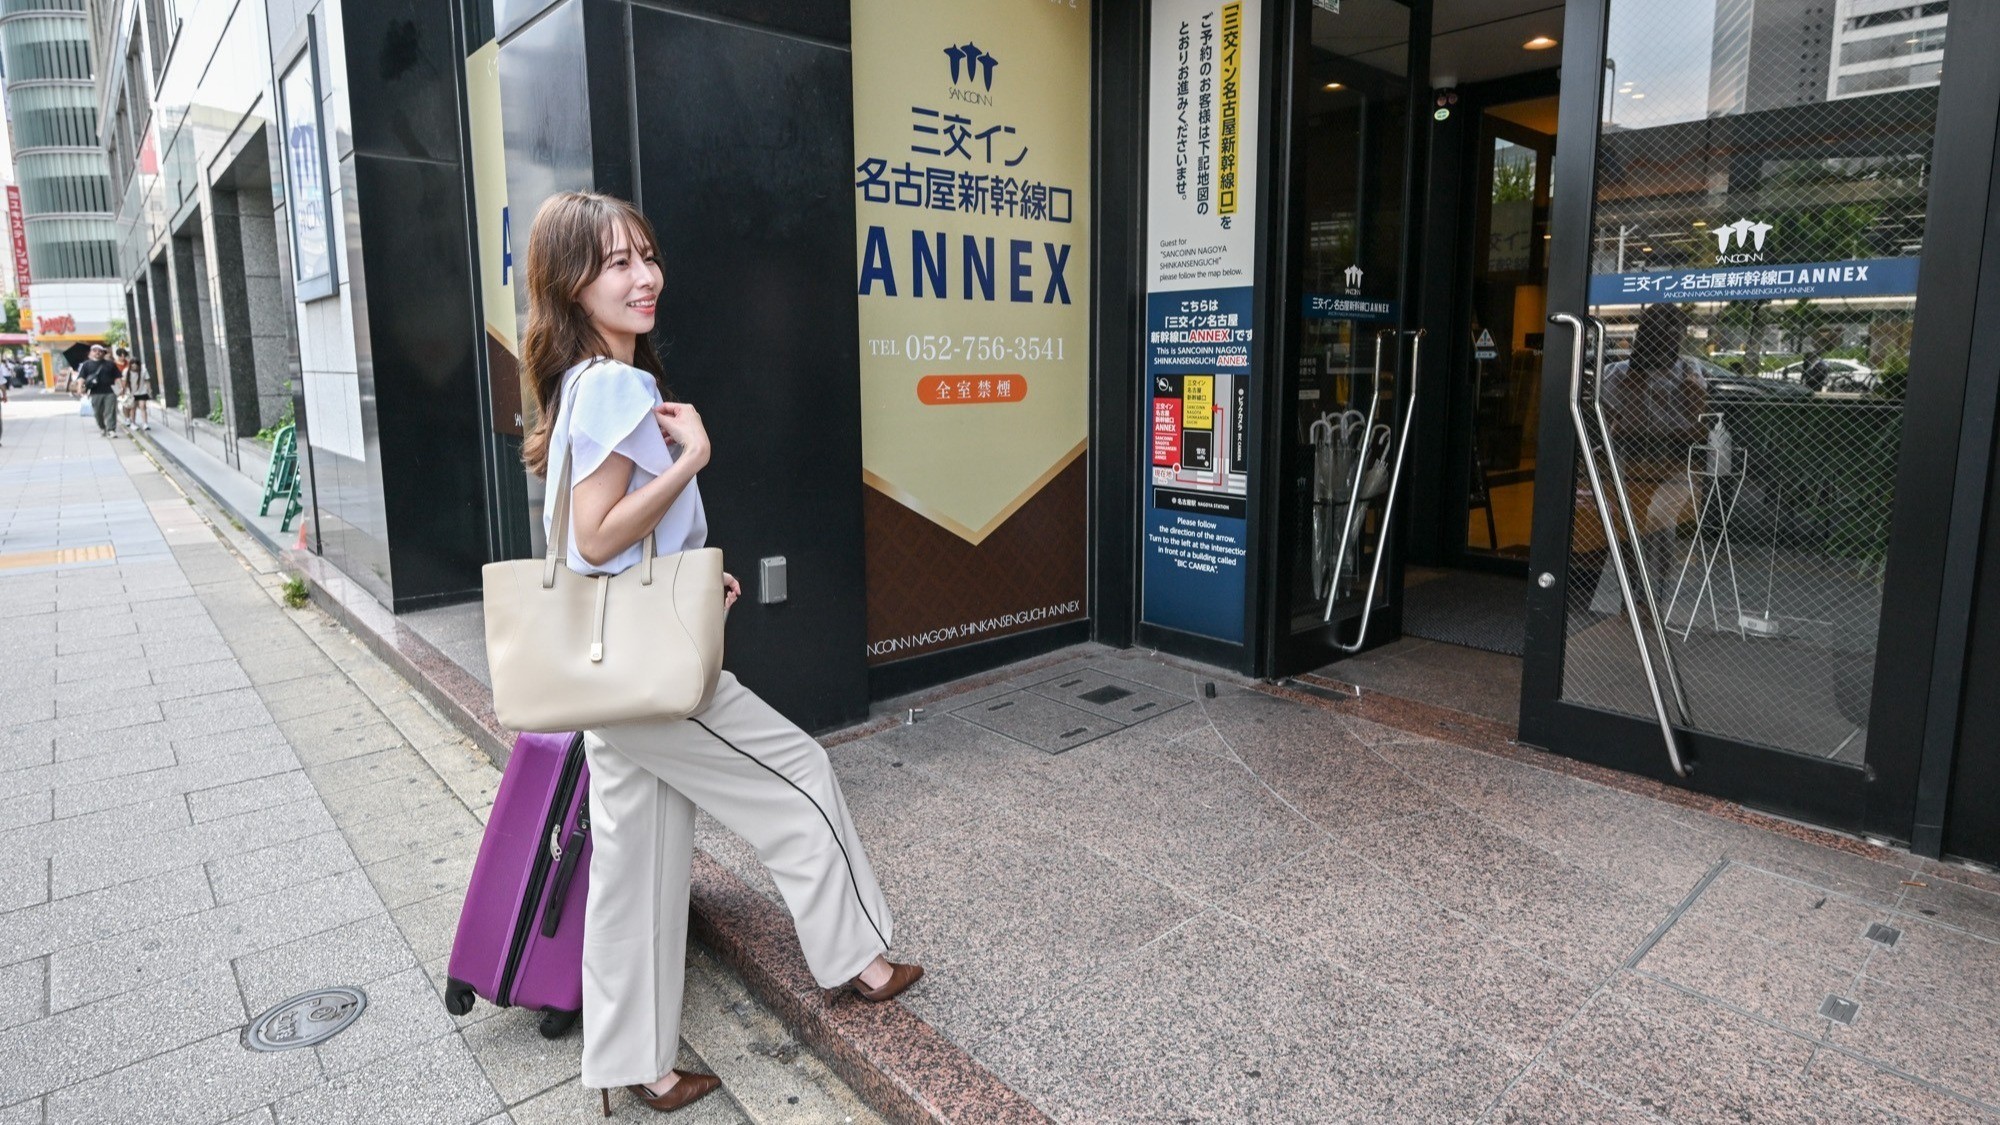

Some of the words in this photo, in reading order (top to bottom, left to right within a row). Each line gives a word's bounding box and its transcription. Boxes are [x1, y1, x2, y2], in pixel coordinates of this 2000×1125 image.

[948, 86, 993, 107] SANCOINN
[1176, 21, 1190, 200] とおりお進みくださいませ。
[1197, 11, 1213, 215] ご予約のお客様は下記地図の
[1219, 4, 1240, 230] 「三交イン名古屋新幹線口」を
[911, 106, 1028, 167] 三交イン
[855, 157, 1072, 223] 名古屋新幹線口
[1160, 239, 1177, 248] Guest
[1160, 248, 1196, 259] "SANCOINN
[1198, 245, 1227, 255] NAGOYA
[1715, 252, 1764, 264] SANCOINN
[858, 225, 1072, 305] ANNEX
[1160, 257, 1222, 270] SHINKANSENGUCHI"
[1160, 274, 1177, 283] please
[1179, 271, 1196, 280] follow
[1222, 268, 1243, 276] below.
[1797, 265, 1869, 284] ANNEX
[1724, 288, 1786, 296] SHINKANSENGUCHI
[1788, 286, 1815, 294] ANNEX
[1180, 299, 1219, 313] こちらは
[1370, 302, 1389, 313] ANNEX
[1164, 313, 1239, 328] 「三交イン名古屋
[869, 339, 900, 356] TEL
[905, 334, 1065, 362] 052-756-3541
[1157, 347, 1169, 355] This
[1171, 347, 1176, 355] is
[1177, 346, 1214, 355] SANCOINN
[1215, 346, 1247, 354] NAGOYA
[1153, 356, 1216, 365] SHINKANSENGUCHI
[936, 380, 1012, 400] 全室禁煙
[1155, 402, 1174, 410] 三交イン
[1155, 423, 1176, 432] ANNEX
[1177, 517, 1197, 527] Please
[1197, 519, 1217, 529] follow
[1148, 533, 1162, 542] Turn
[1162, 536, 1169, 544] to
[1170, 537, 1180, 546] the
[1181, 538, 1191, 547] left
[1192, 541, 1199, 549] at
[1199, 541, 1210, 550] the
[1159, 525, 1169, 533] the
[1170, 526, 1195, 537] direction
[1196, 530, 1203, 538] of
[1204, 531, 1214, 540] the
[1215, 535, 1236, 543] arrow.
[1157, 546, 1164, 554] in
[1164, 546, 1179, 556] front
[1179, 549, 1186, 557] of
[1192, 551, 1217, 564] building
[1217, 556, 1237, 566] called
[912, 626, 959, 647] NAGOYA
[960, 606, 1047, 637] SHINKANSENGUCHI
[1048, 600, 1080, 617] ANNEX
